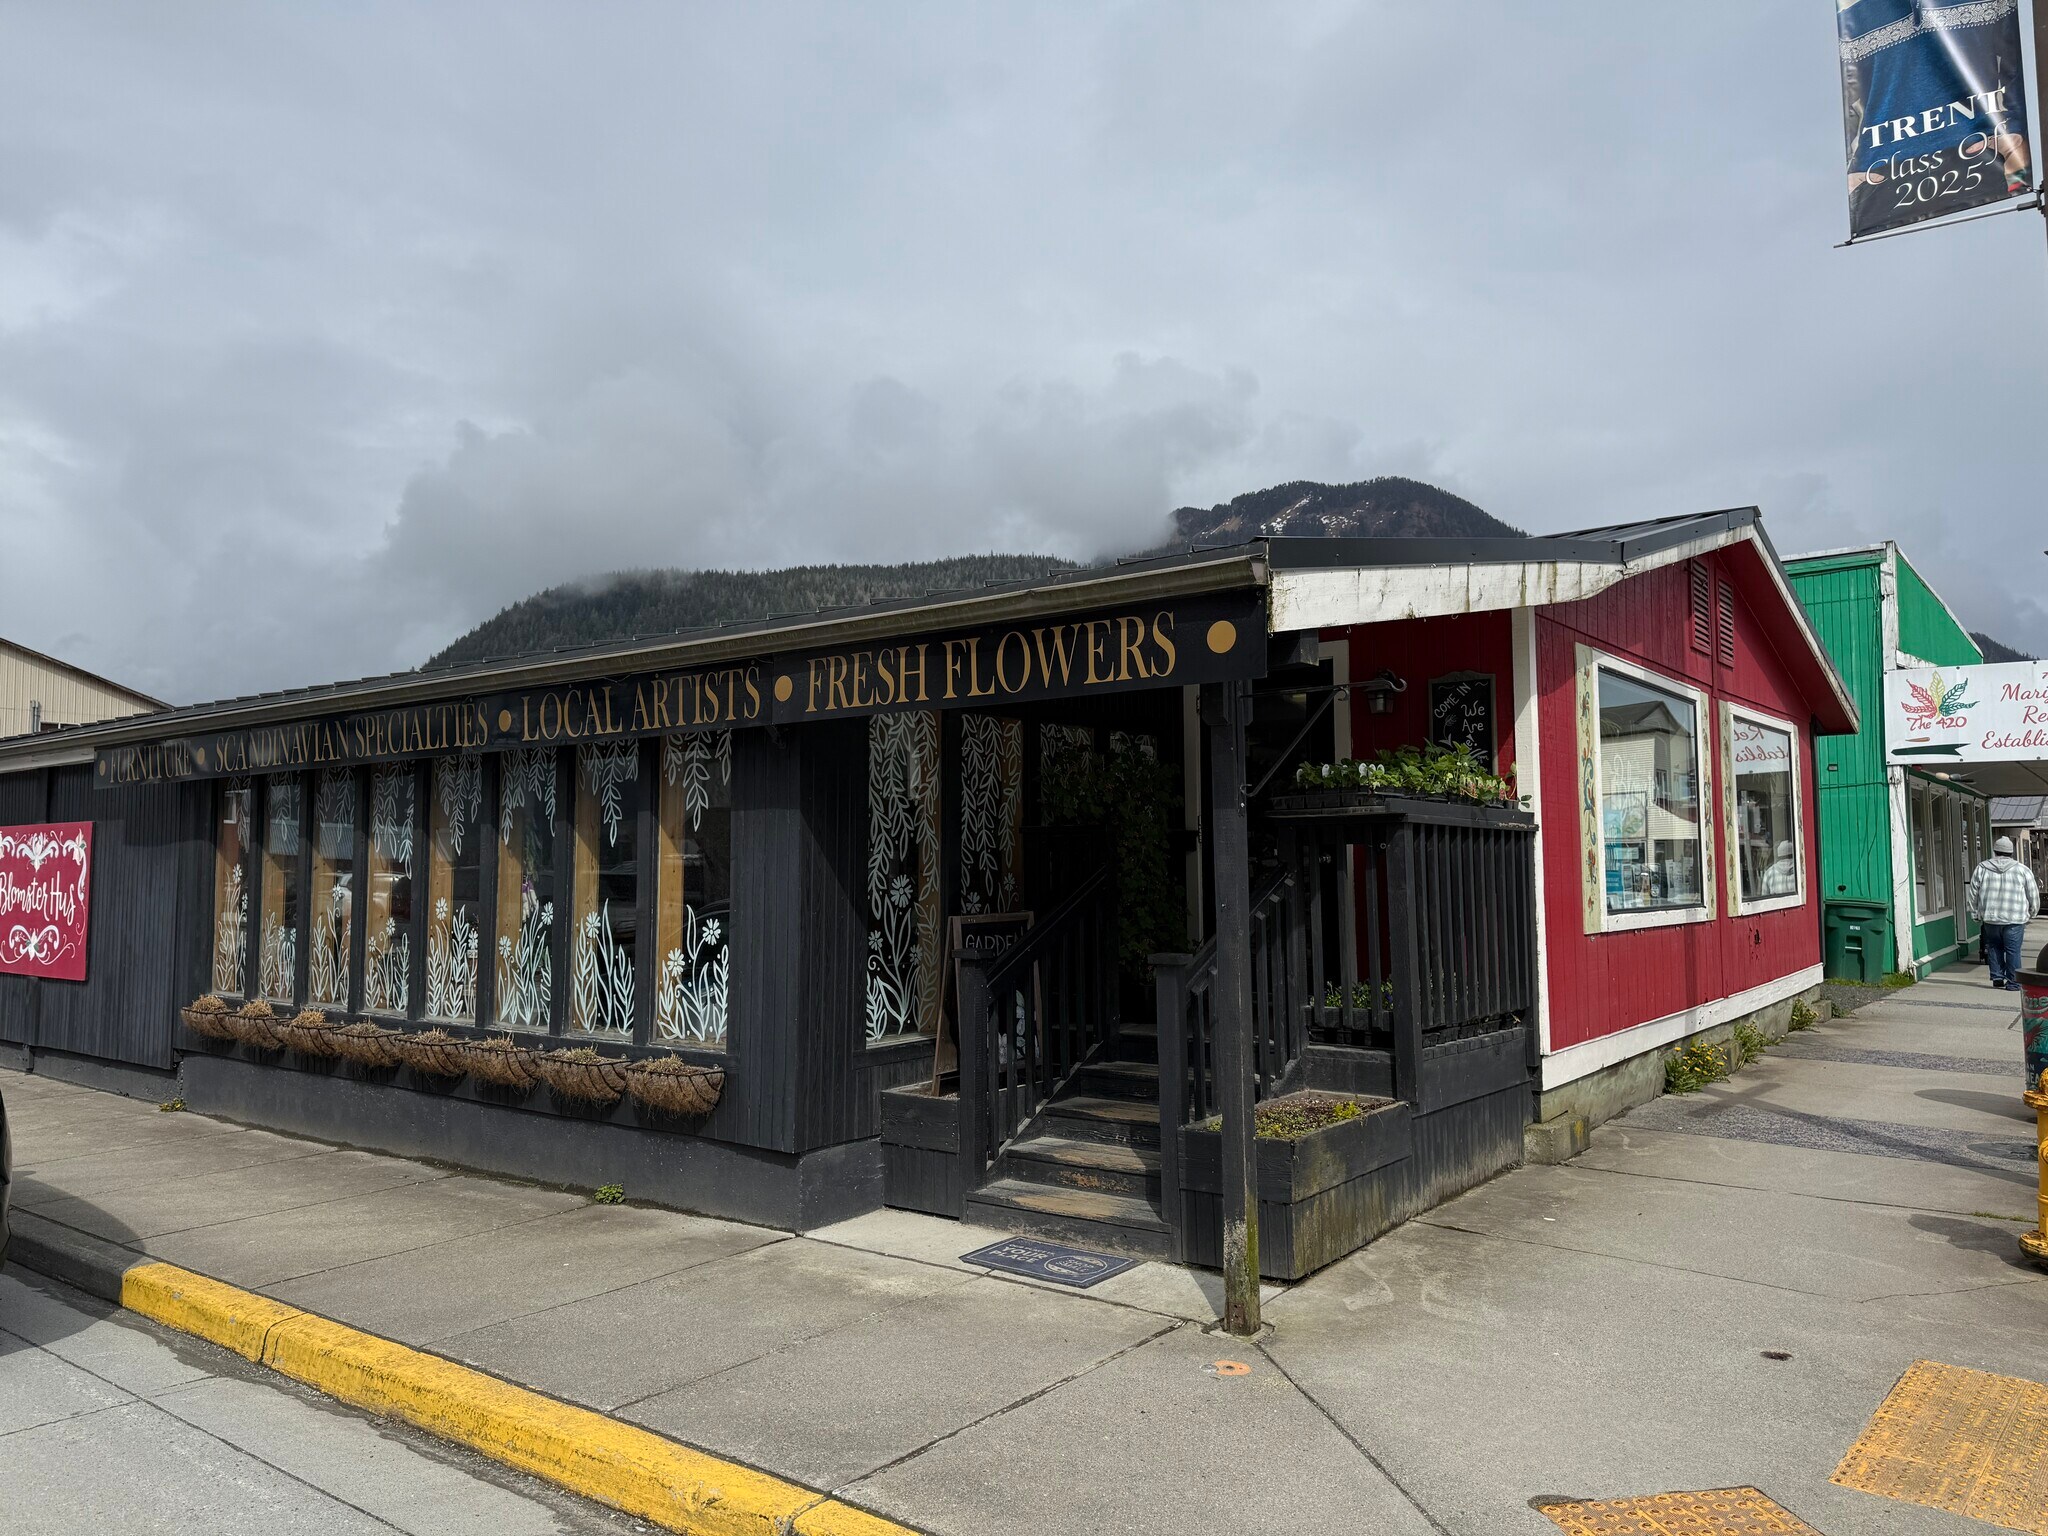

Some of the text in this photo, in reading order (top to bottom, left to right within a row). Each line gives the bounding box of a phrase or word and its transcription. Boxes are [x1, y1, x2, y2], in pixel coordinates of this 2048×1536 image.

[1862, 86, 2008, 148] TRENT
[1866, 118, 2009, 185] Class Of
[1894, 160, 1983, 209] 2025
[110, 611, 1176, 783] FURNITURE SCANDINAVIAN SPECIALTIES LOCAL ARTISTS FRESH FLOWERS
[1434, 682, 1471, 718] COME IN
[1461, 700, 1485, 717] We
[1462, 719, 1484, 734] Are
[1907, 715, 1967, 732] The 420
[2022, 705, 2048, 725] Re
[50, 870, 76, 927] Hus
[988, 1250, 1040, 1264] PLACE
[1003, 1246, 1048, 1260] YOUR
